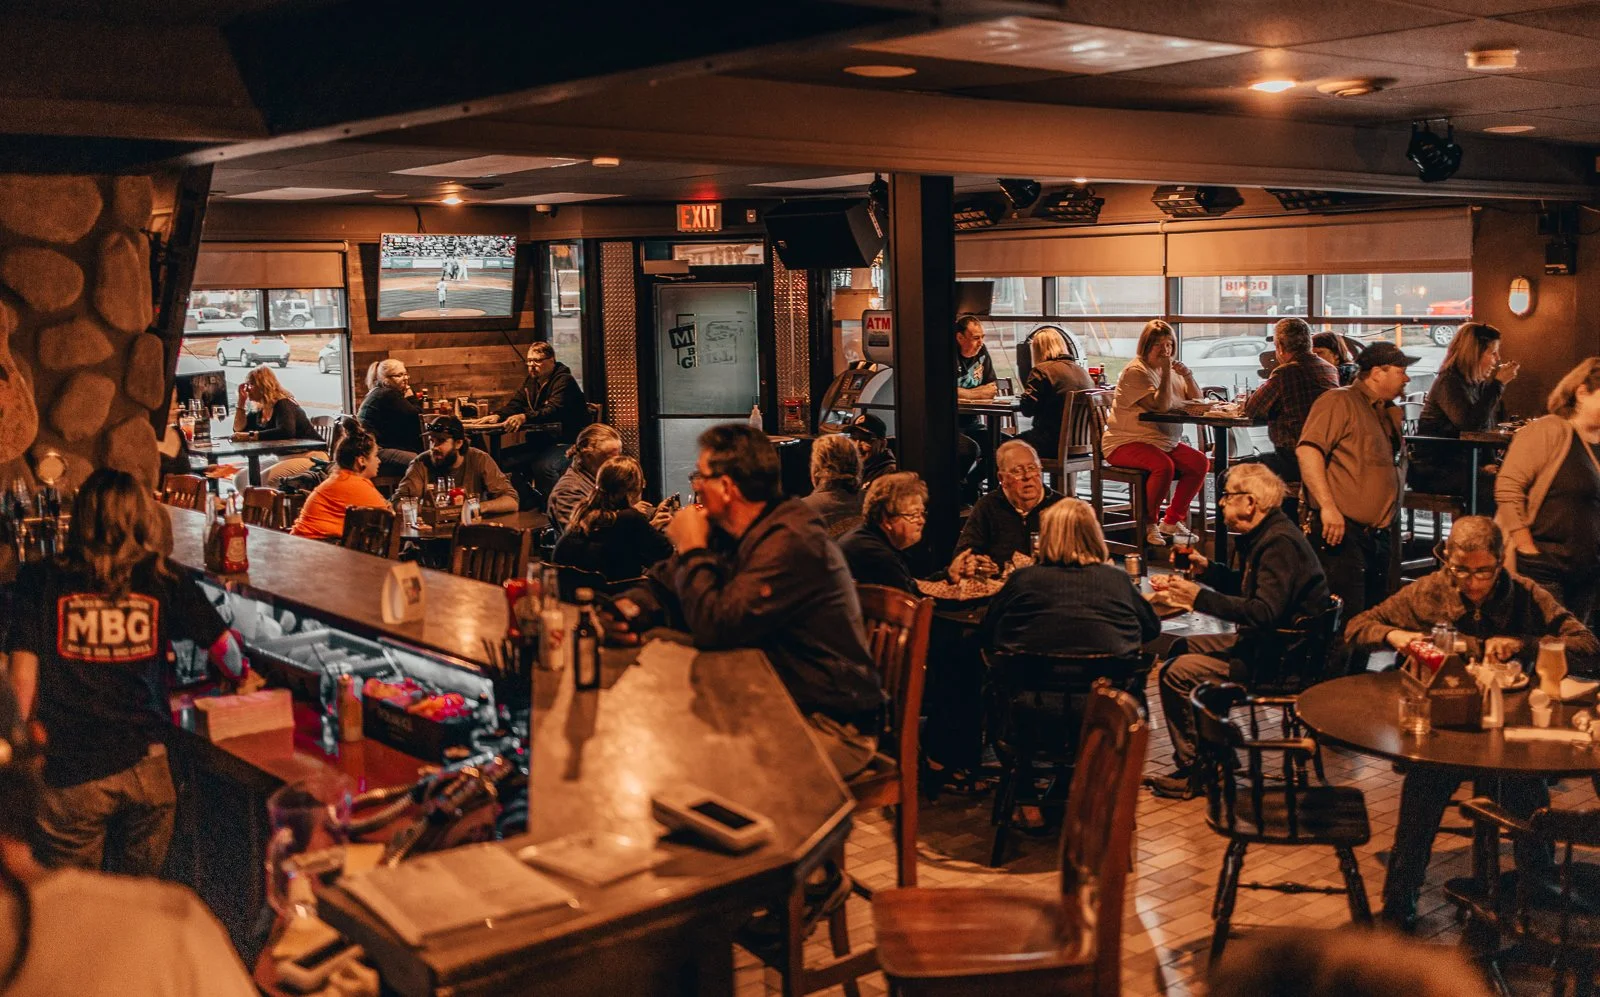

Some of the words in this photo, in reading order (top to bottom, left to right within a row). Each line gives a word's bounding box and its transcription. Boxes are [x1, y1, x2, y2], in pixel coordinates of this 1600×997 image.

[681, 205, 717, 229] EXIT
[1225, 281, 1268, 291] BINGO
[866, 317, 891, 330] ATM
[68, 609, 150, 645] MBG
